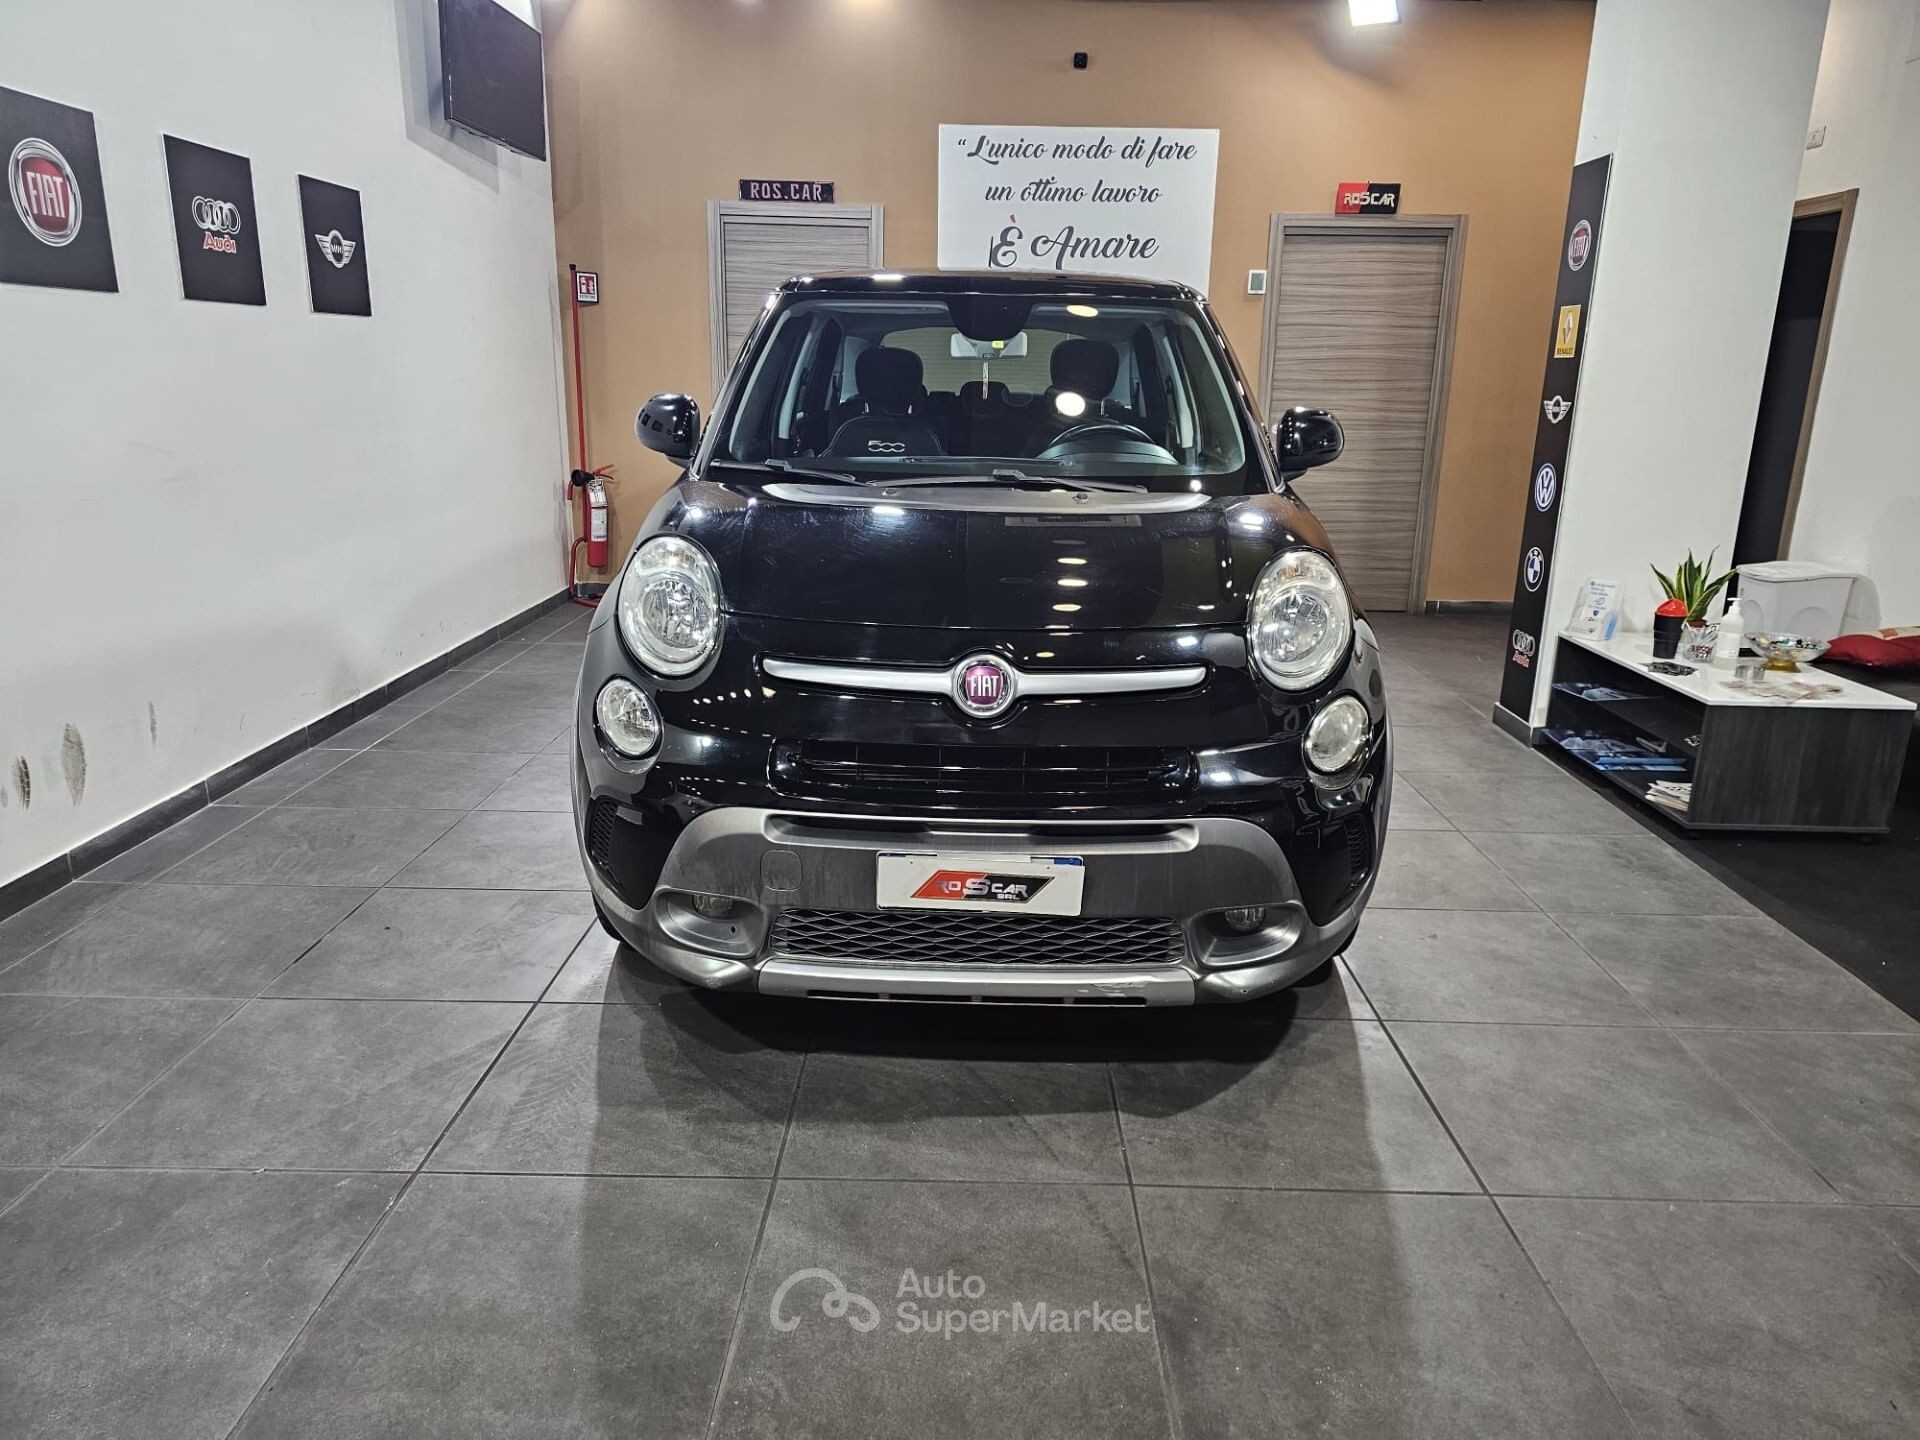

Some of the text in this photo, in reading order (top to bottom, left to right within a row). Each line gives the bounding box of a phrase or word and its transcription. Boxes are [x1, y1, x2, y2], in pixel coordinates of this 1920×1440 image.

[1052, 136, 1115, 159] modo
[1120, 136, 1145, 159] di
[1144, 136, 1198, 168] fare
[26, 171, 67, 218] FIAT
[750, 182, 822, 201] ROS.CAR
[985, 176, 1163, 202] un ottimo lavoro
[1343, 191, 1396, 207] ROSCAR
[203, 230, 237, 254] Audi
[1030, 225, 1160, 270] Amare
[868, 440, 905, 452] 500
[970, 675, 999, 697] FIAT
